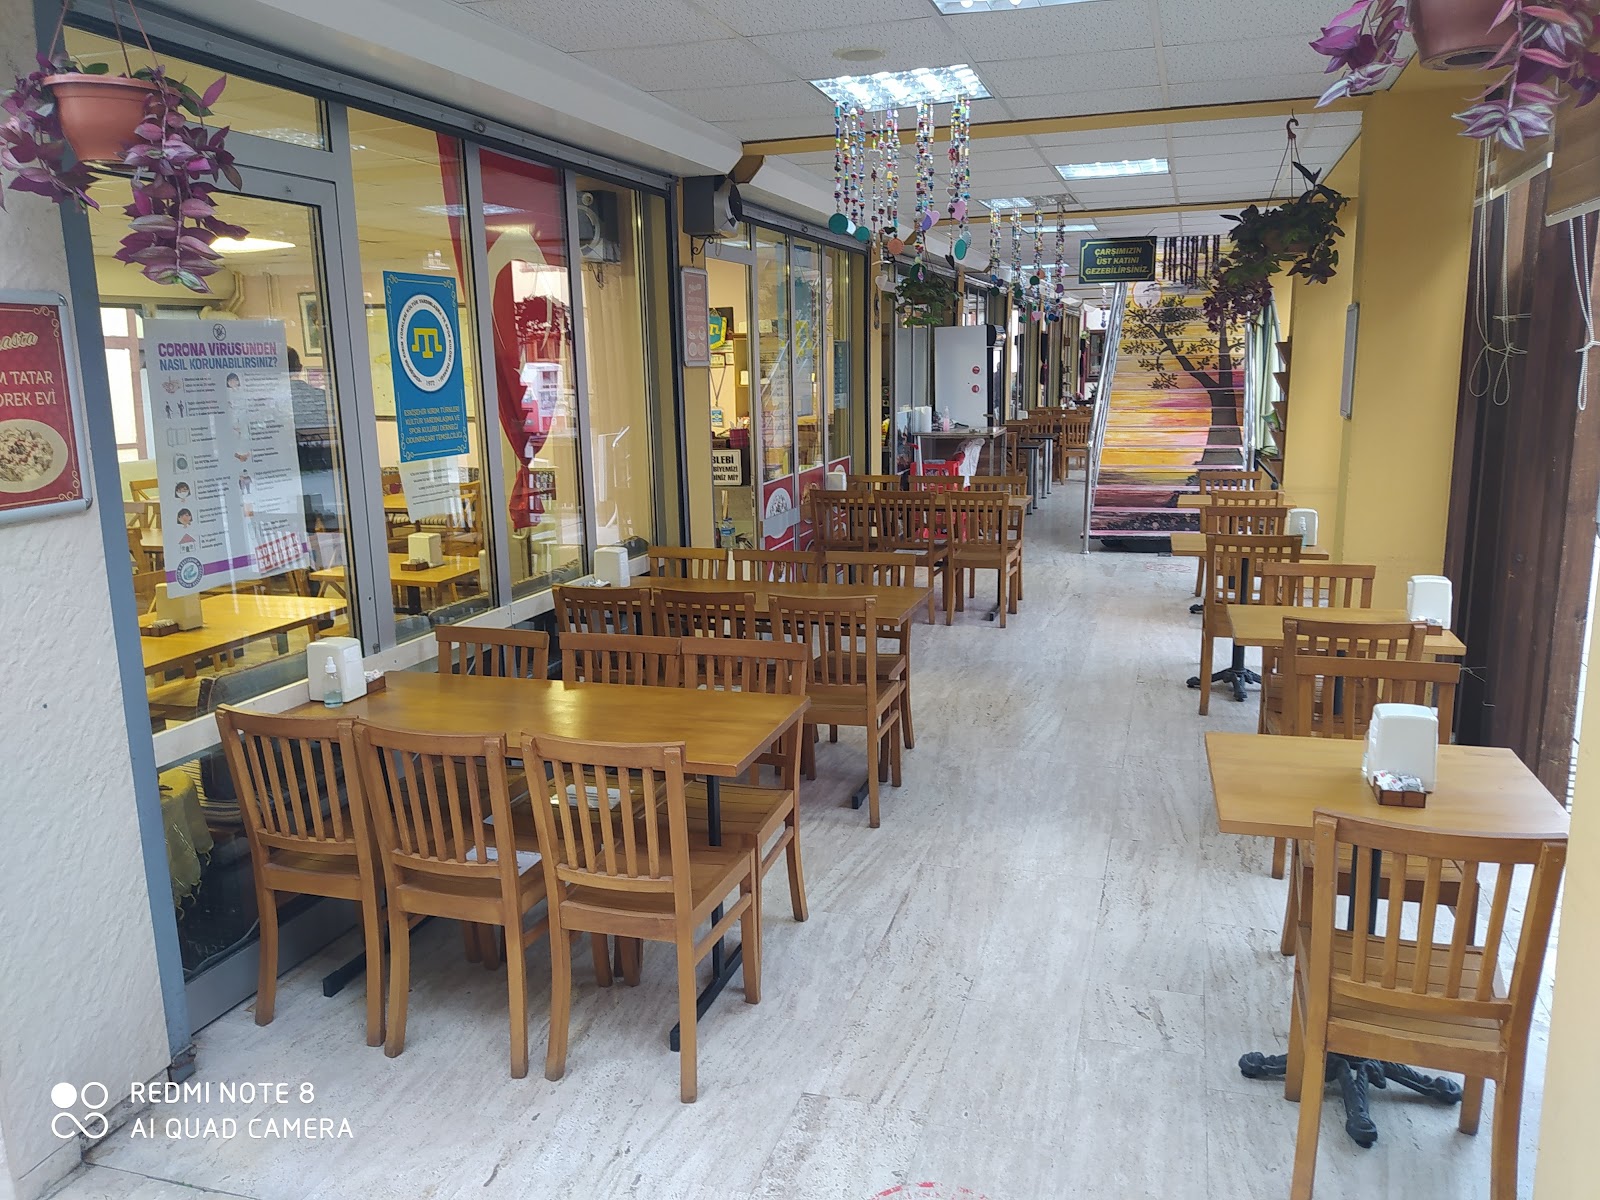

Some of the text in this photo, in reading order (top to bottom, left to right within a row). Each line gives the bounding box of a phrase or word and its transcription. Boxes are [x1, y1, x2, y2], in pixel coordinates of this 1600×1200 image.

[1094, 247, 1142, 256] ÇARŞIMIZIN
[1096, 257, 1112, 265] ÜST
[1085, 265, 1149, 275] GEZEBİLİRSİNİZ.
[158, 341, 277, 357] CORONA VİRÜSÜNDEN
[160, 357, 278, 371] NASIL KORUNABİLİRSİNİZ?
[9, 370, 54, 385] TATAR
[35, 388, 57, 405] EVİ
